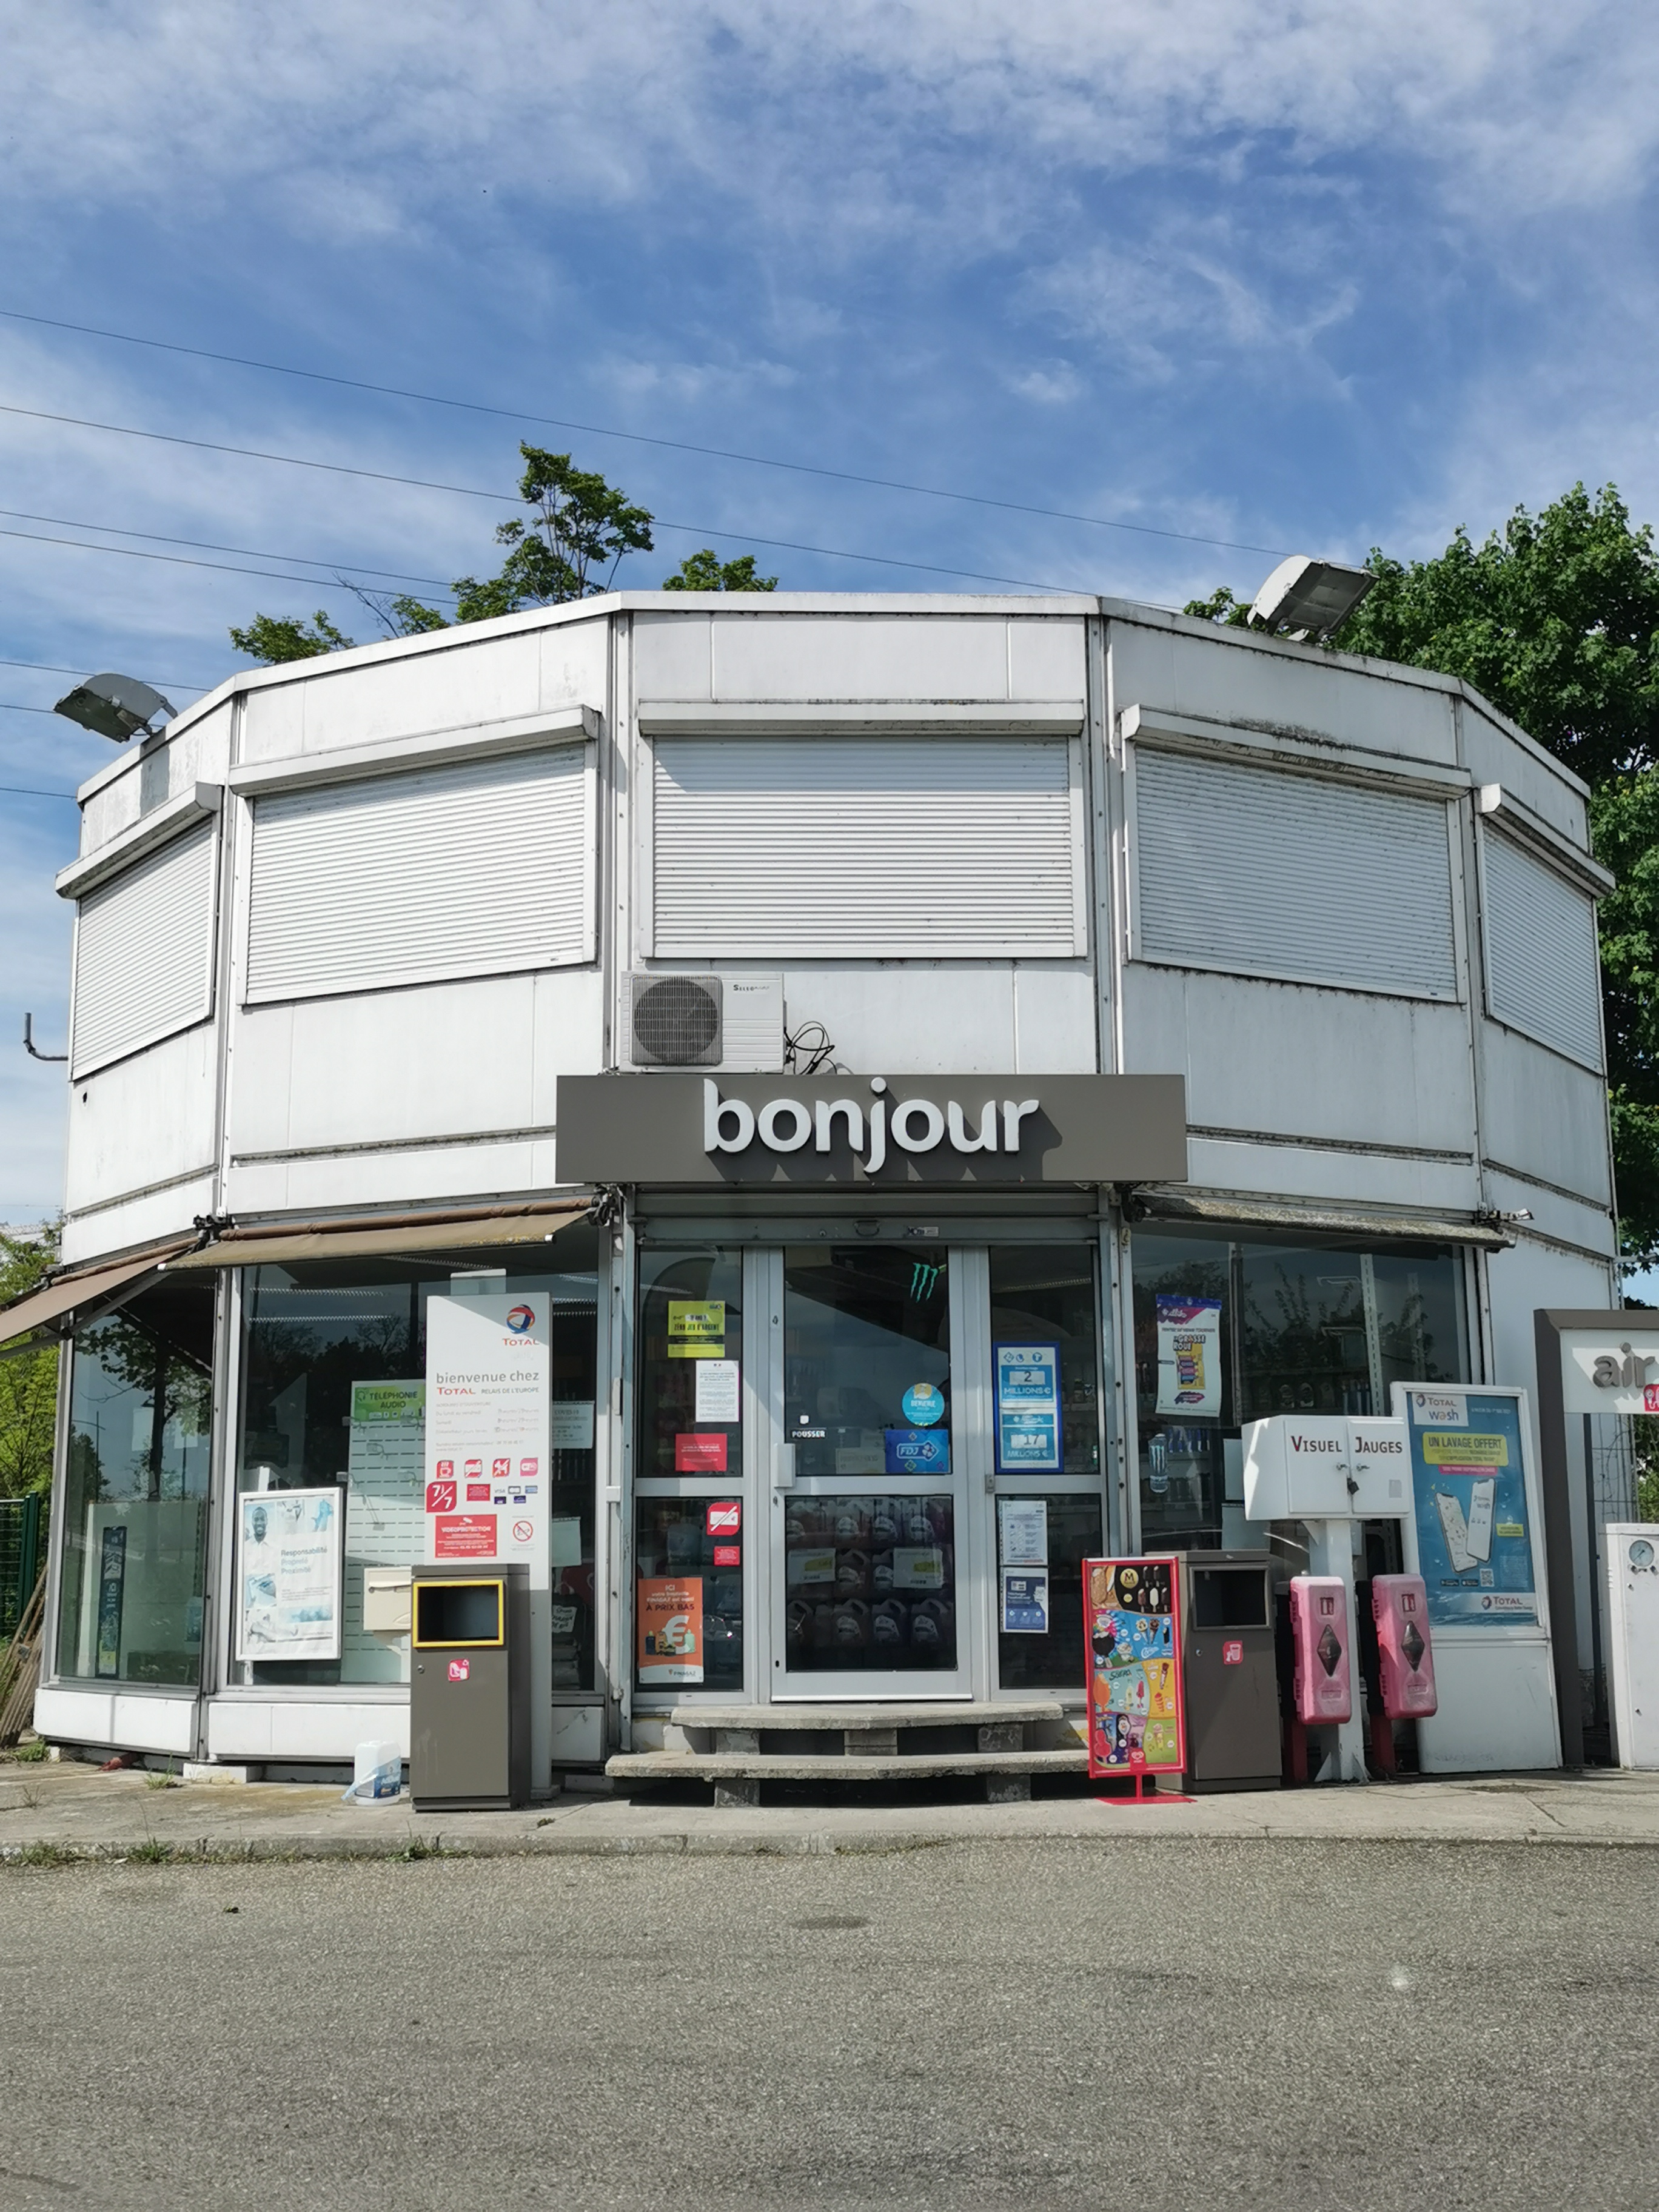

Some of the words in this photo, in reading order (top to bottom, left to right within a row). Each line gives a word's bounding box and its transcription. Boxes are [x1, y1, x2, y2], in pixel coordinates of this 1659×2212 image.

[704, 1077, 1039, 1173] bonjour
[1173, 1342, 1192, 1351] ROUE
[1593, 1342, 1655, 1388] air
[437, 1372, 506, 1384] bienvenue
[510, 1370, 539, 1381] chez
[1024, 1371, 1032, 1382] 2
[380, 1401, 406, 1409] AUDIO
[1427, 1397, 1456, 1407] TOTAL
[1429, 1409, 1459, 1421] wash
[1024, 1435, 1039, 1445] 17
[1291, 1435, 1342, 1452] VISUEL
[1355, 1436, 1403, 1453] JAUGES
[1428, 1436, 1439, 1447] UN
[1441, 1436, 1473, 1448] LAVAGE
[1473, 1438, 1502, 1449] OFFERT
[900, 1447, 919, 1455] FDJ
[281, 1546, 327, 1557] Responsabilité
[281, 1566, 311, 1574] Proximité
[1124, 1573, 1135, 1584] M
[1493, 1596, 1523, 1605] TOTAL
[646, 1603, 652, 1611] À
